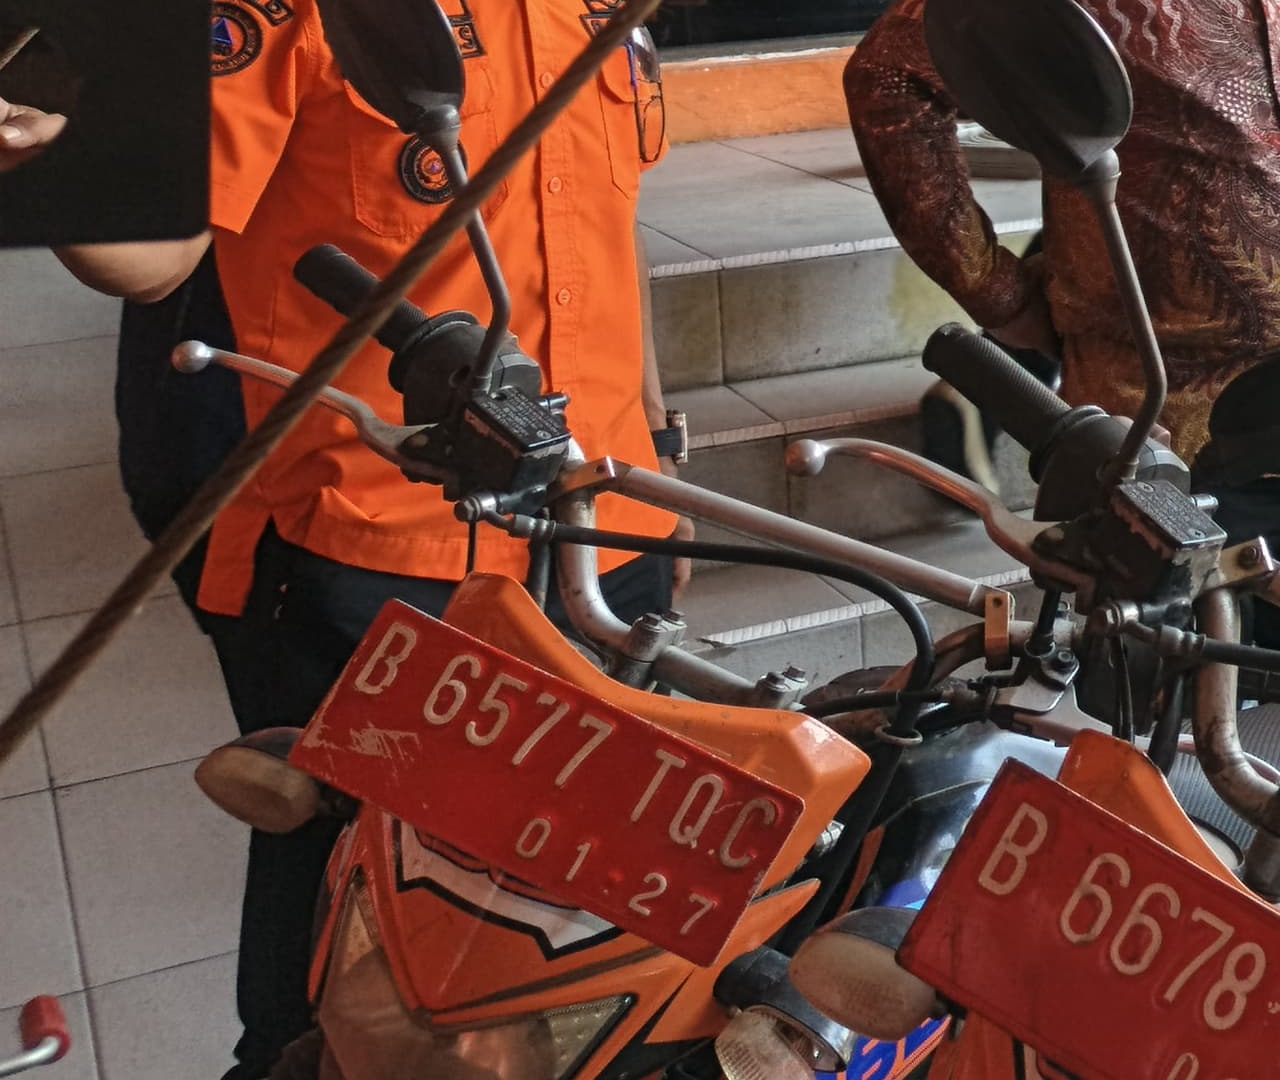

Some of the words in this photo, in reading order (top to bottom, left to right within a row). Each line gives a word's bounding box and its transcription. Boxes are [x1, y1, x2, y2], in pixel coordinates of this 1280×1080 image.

[353, 622, 417, 695] B
[423, 654, 614, 788] 6577
[630, 749, 777, 868] TQC
[978, 802, 1049, 896] B
[1060, 852, 1266, 1031] 6678
